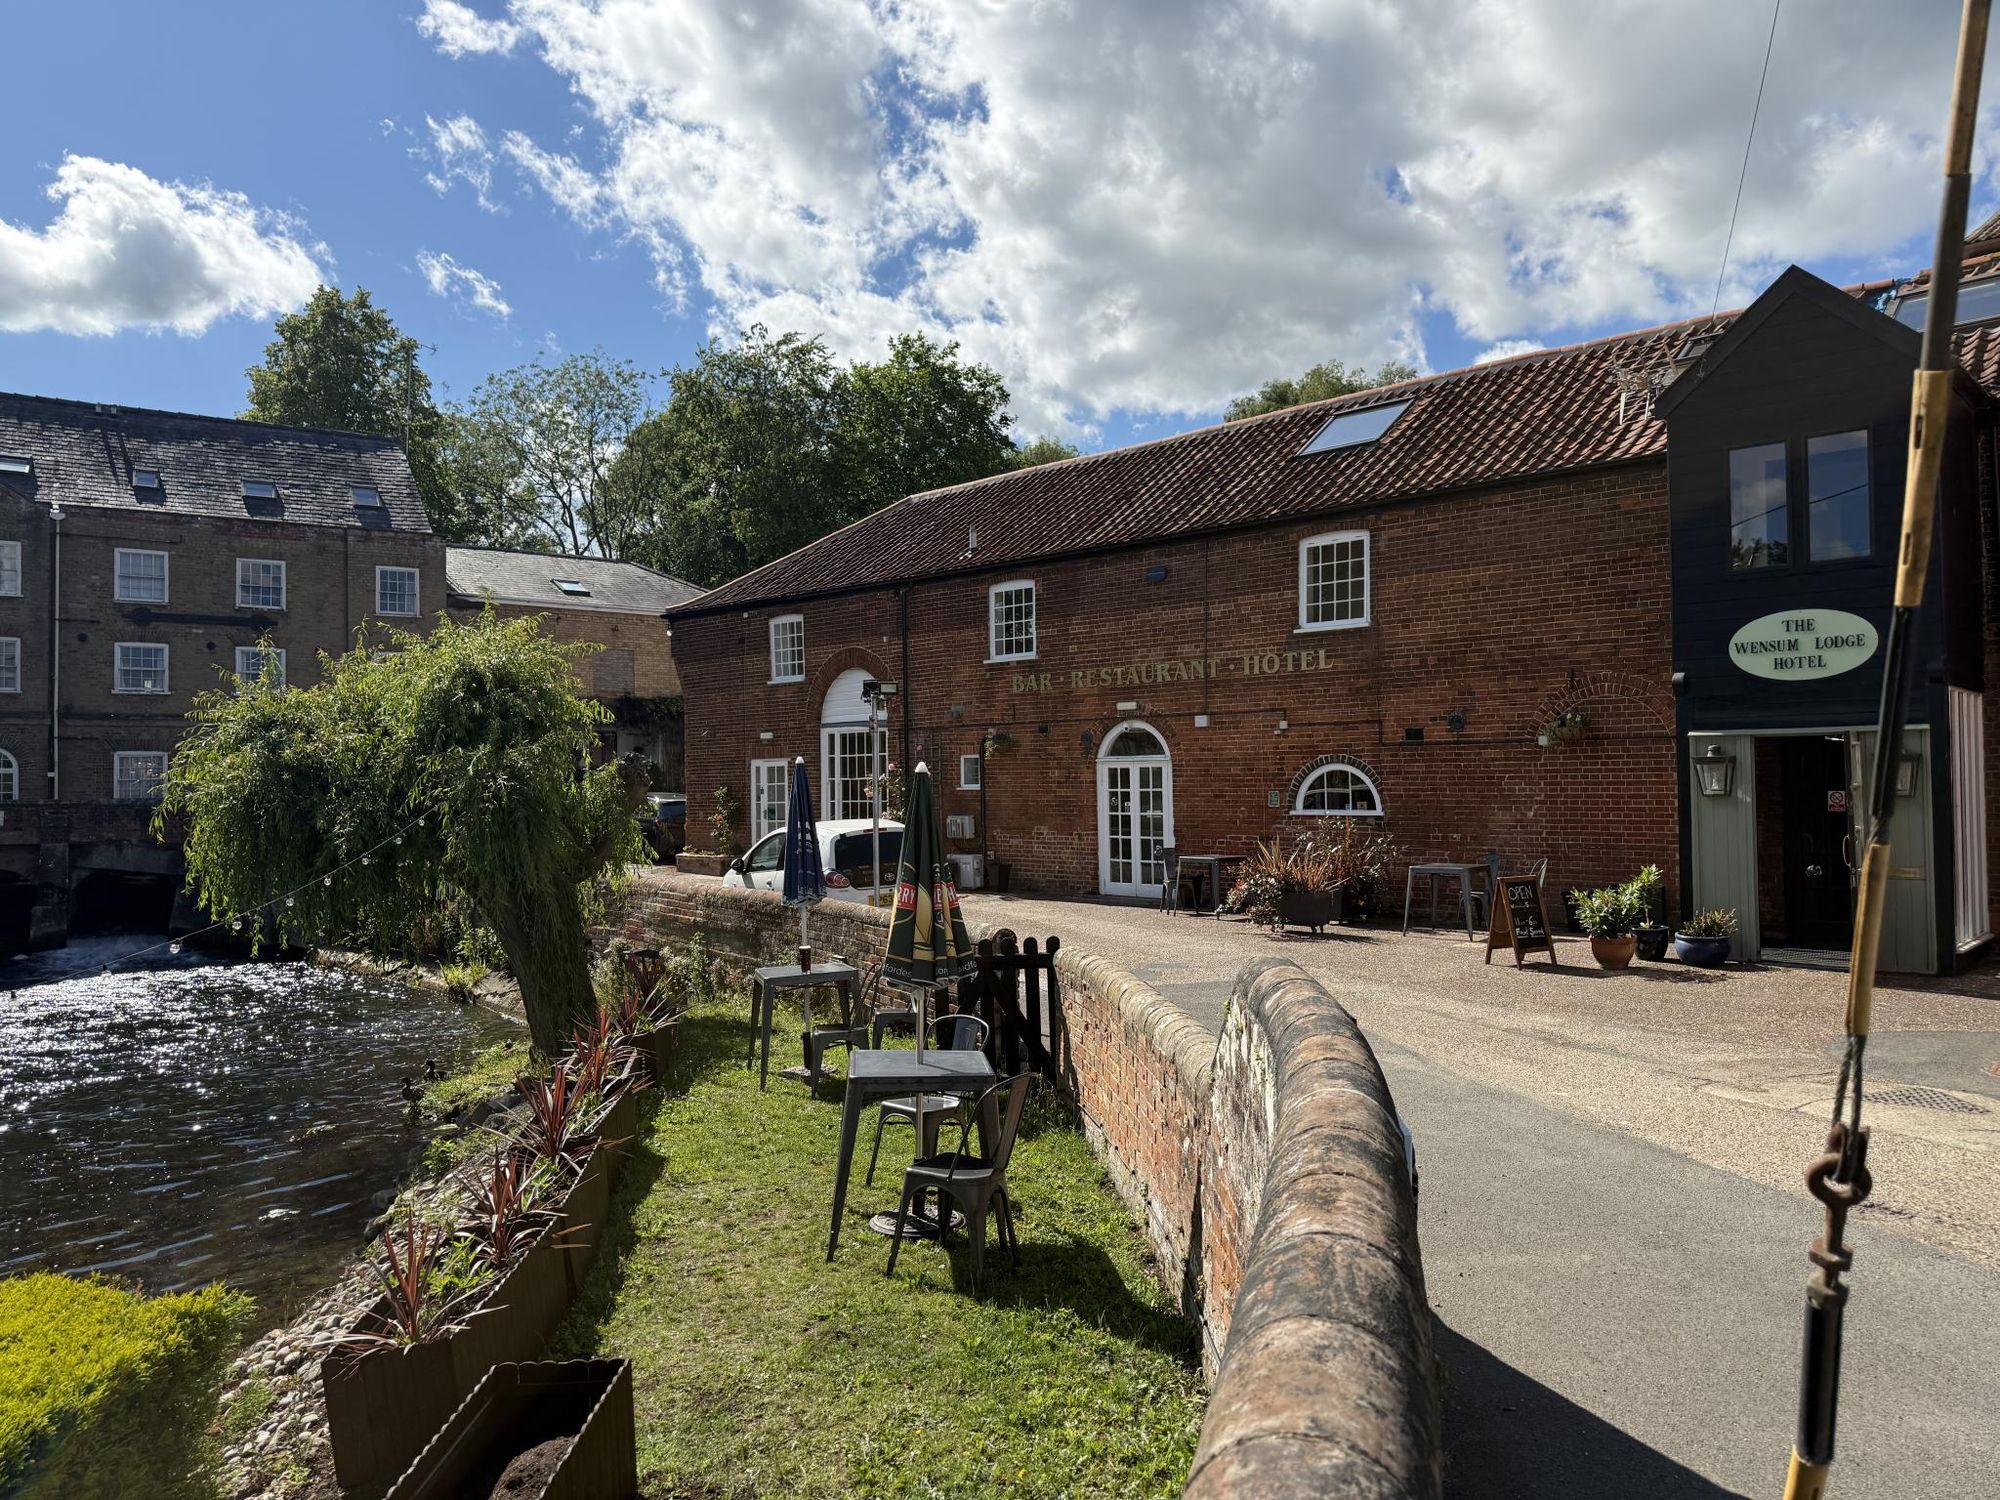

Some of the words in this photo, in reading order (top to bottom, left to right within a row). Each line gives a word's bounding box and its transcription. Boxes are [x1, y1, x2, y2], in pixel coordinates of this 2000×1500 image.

[1781, 618, 1816, 633] THE
[1734, 638, 1800, 655] WENSUM
[1815, 633, 1866, 650] LODGE
[1773, 654, 1827, 670] HOTEL
[1011, 673, 1053, 693] BAR
[1071, 657, 1221, 689] RESTAURANT
[1243, 649, 1334, 676] HOTEL
[1508, 885, 1533, 900] OPEN
